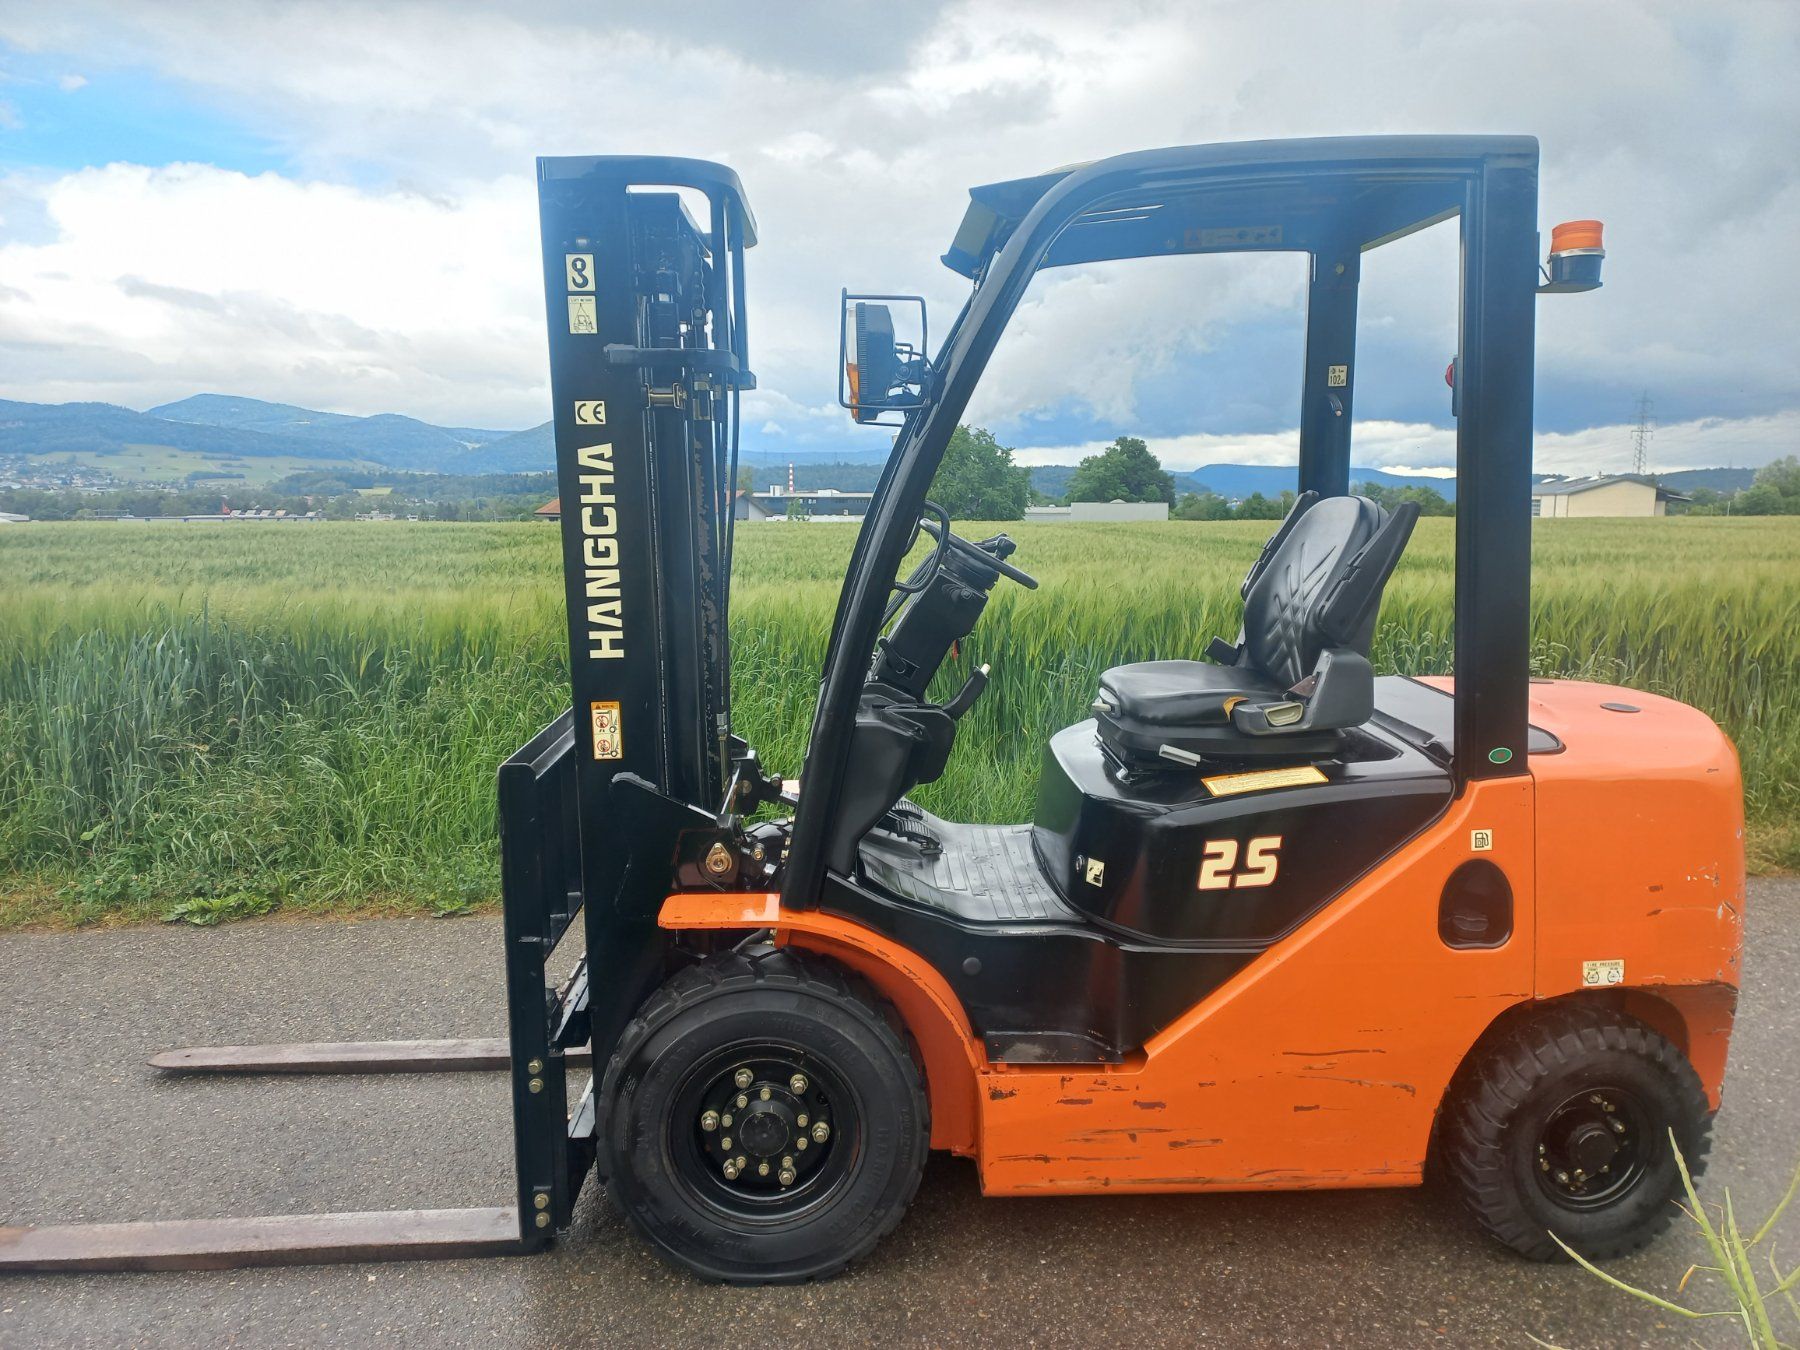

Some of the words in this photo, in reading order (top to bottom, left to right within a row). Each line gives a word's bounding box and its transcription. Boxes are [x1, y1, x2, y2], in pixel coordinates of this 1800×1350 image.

[576, 402, 604, 423] CE
[577, 442, 625, 659] HANGCHA
[1198, 835, 1283, 890] 25
